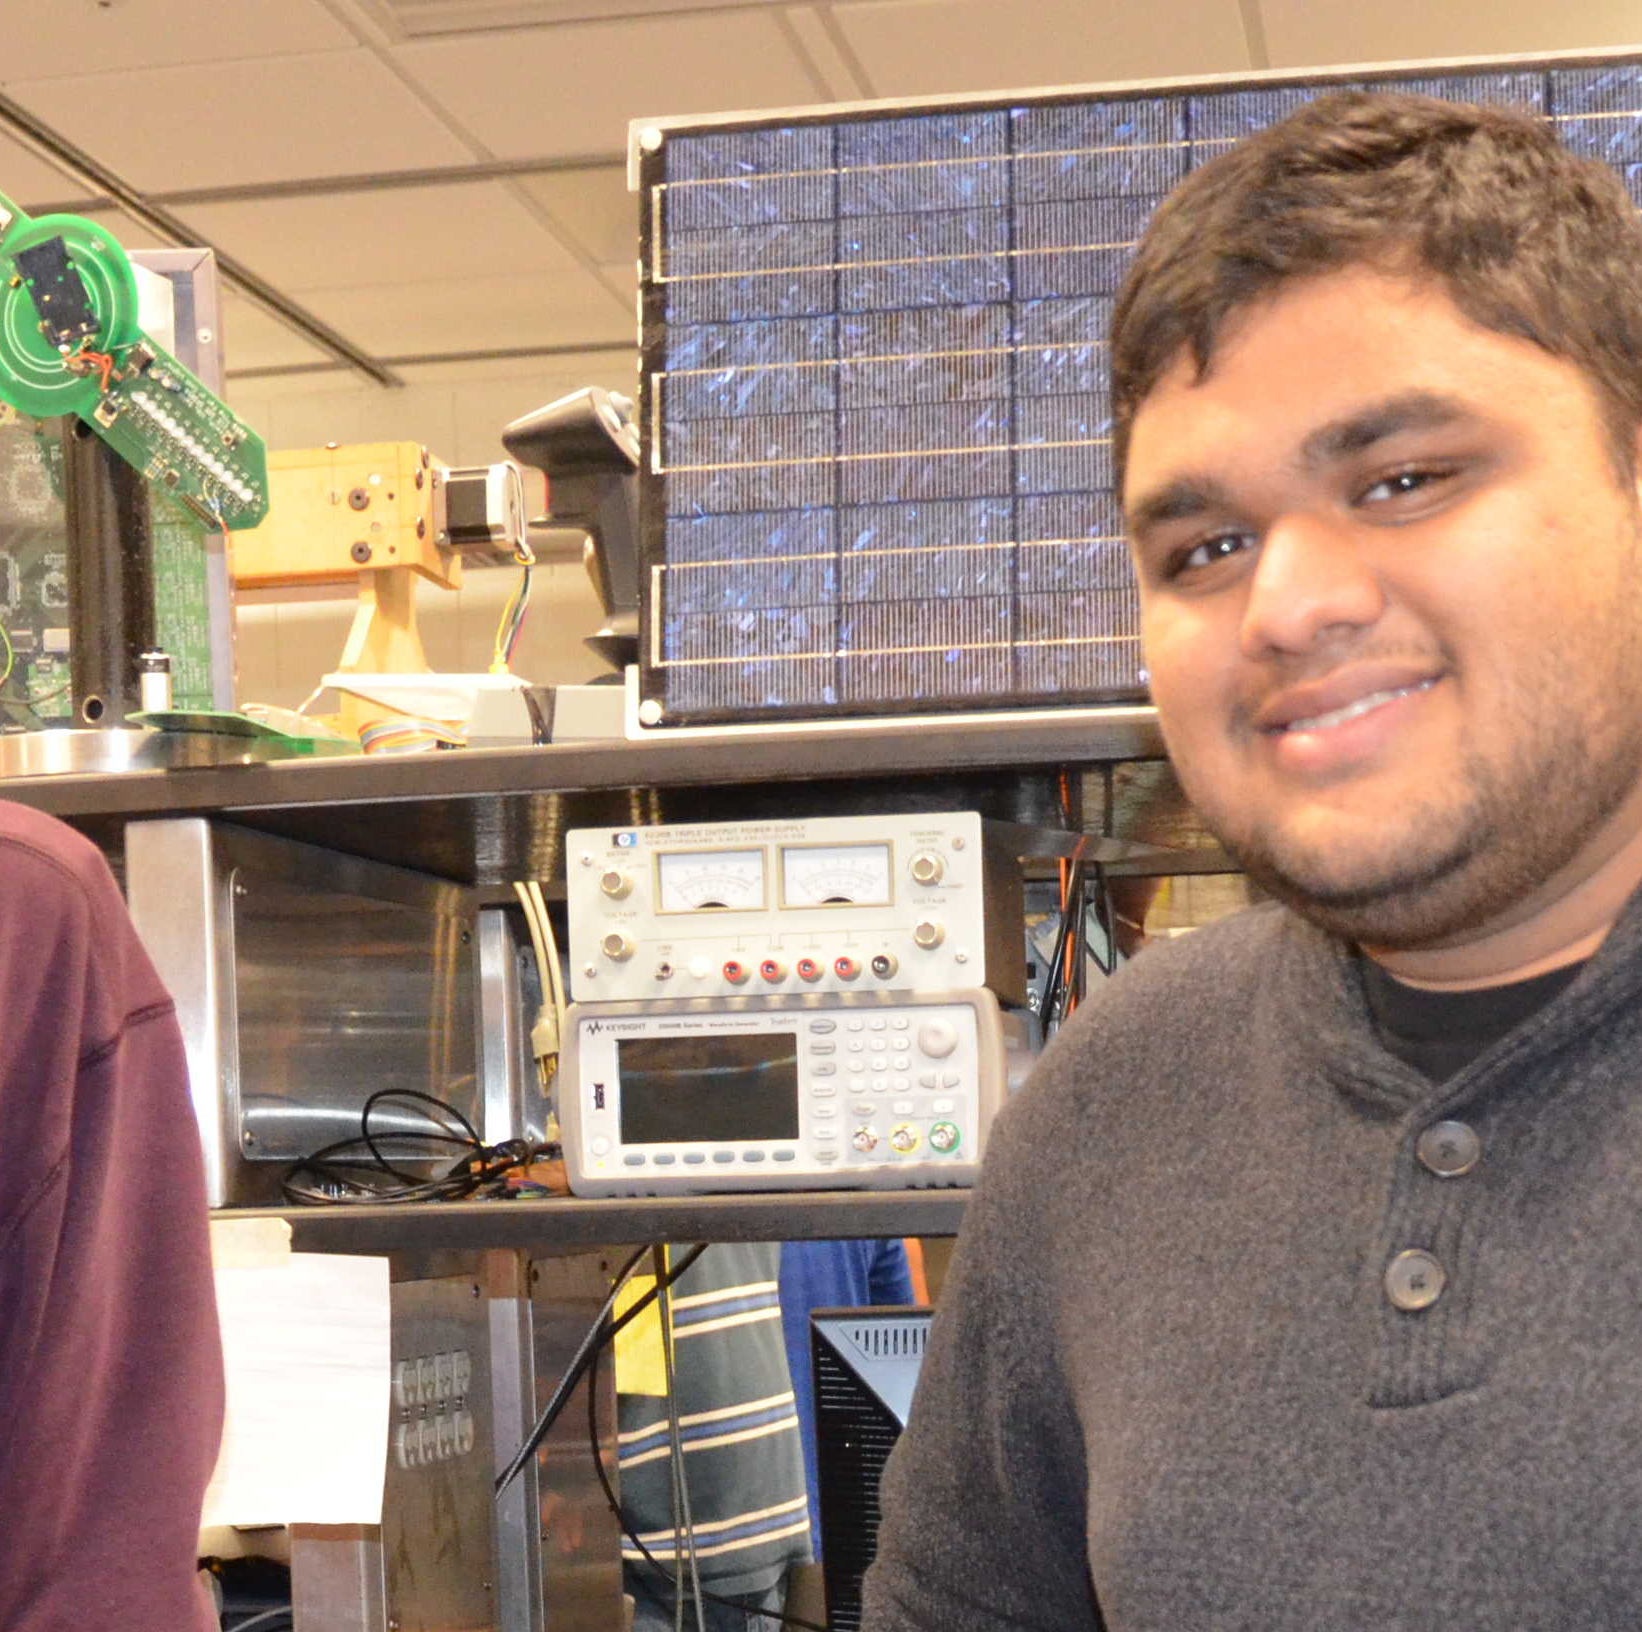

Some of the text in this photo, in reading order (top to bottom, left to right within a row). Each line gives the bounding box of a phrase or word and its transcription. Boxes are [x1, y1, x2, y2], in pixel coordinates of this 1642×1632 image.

[674, 829, 703, 837] TRIPLE
[705, 828, 738, 836] OUTPUT
[741, 826, 771, 834] POWER
[774, 825, 806, 833] SUPPLY
[606, 1022, 646, 1032] KEYSIGHT
